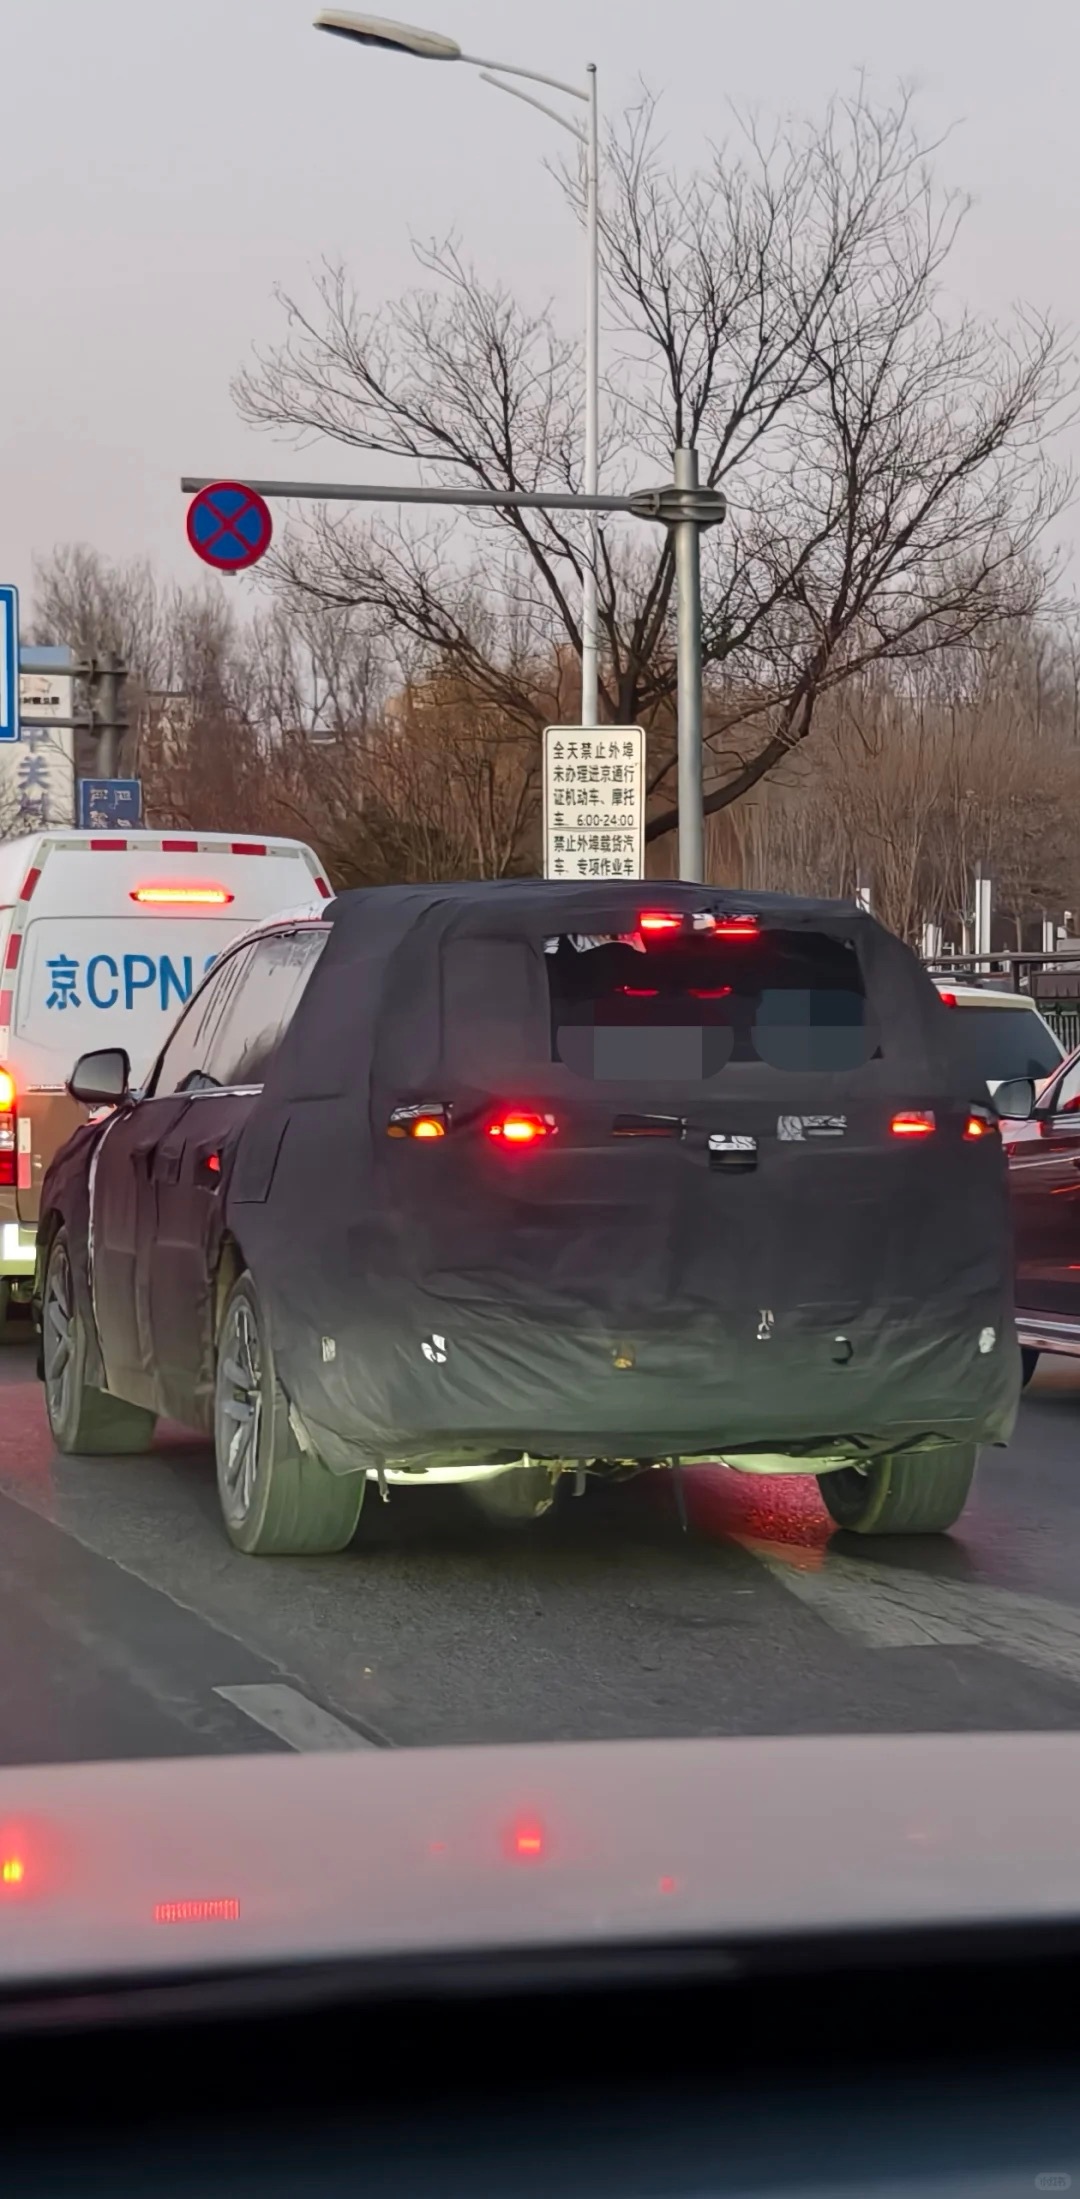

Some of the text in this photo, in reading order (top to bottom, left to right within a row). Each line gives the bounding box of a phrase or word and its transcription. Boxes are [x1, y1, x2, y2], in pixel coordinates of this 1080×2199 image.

[553, 741, 634, 759] 全天禁止外埠
[553, 765, 635, 783] 未办理进京通行
[553, 788, 635, 806] 证机动车、摩托
[554, 835, 634, 852] 禁止外埠载货汽
[46, 954, 220, 1011] 京CPN
